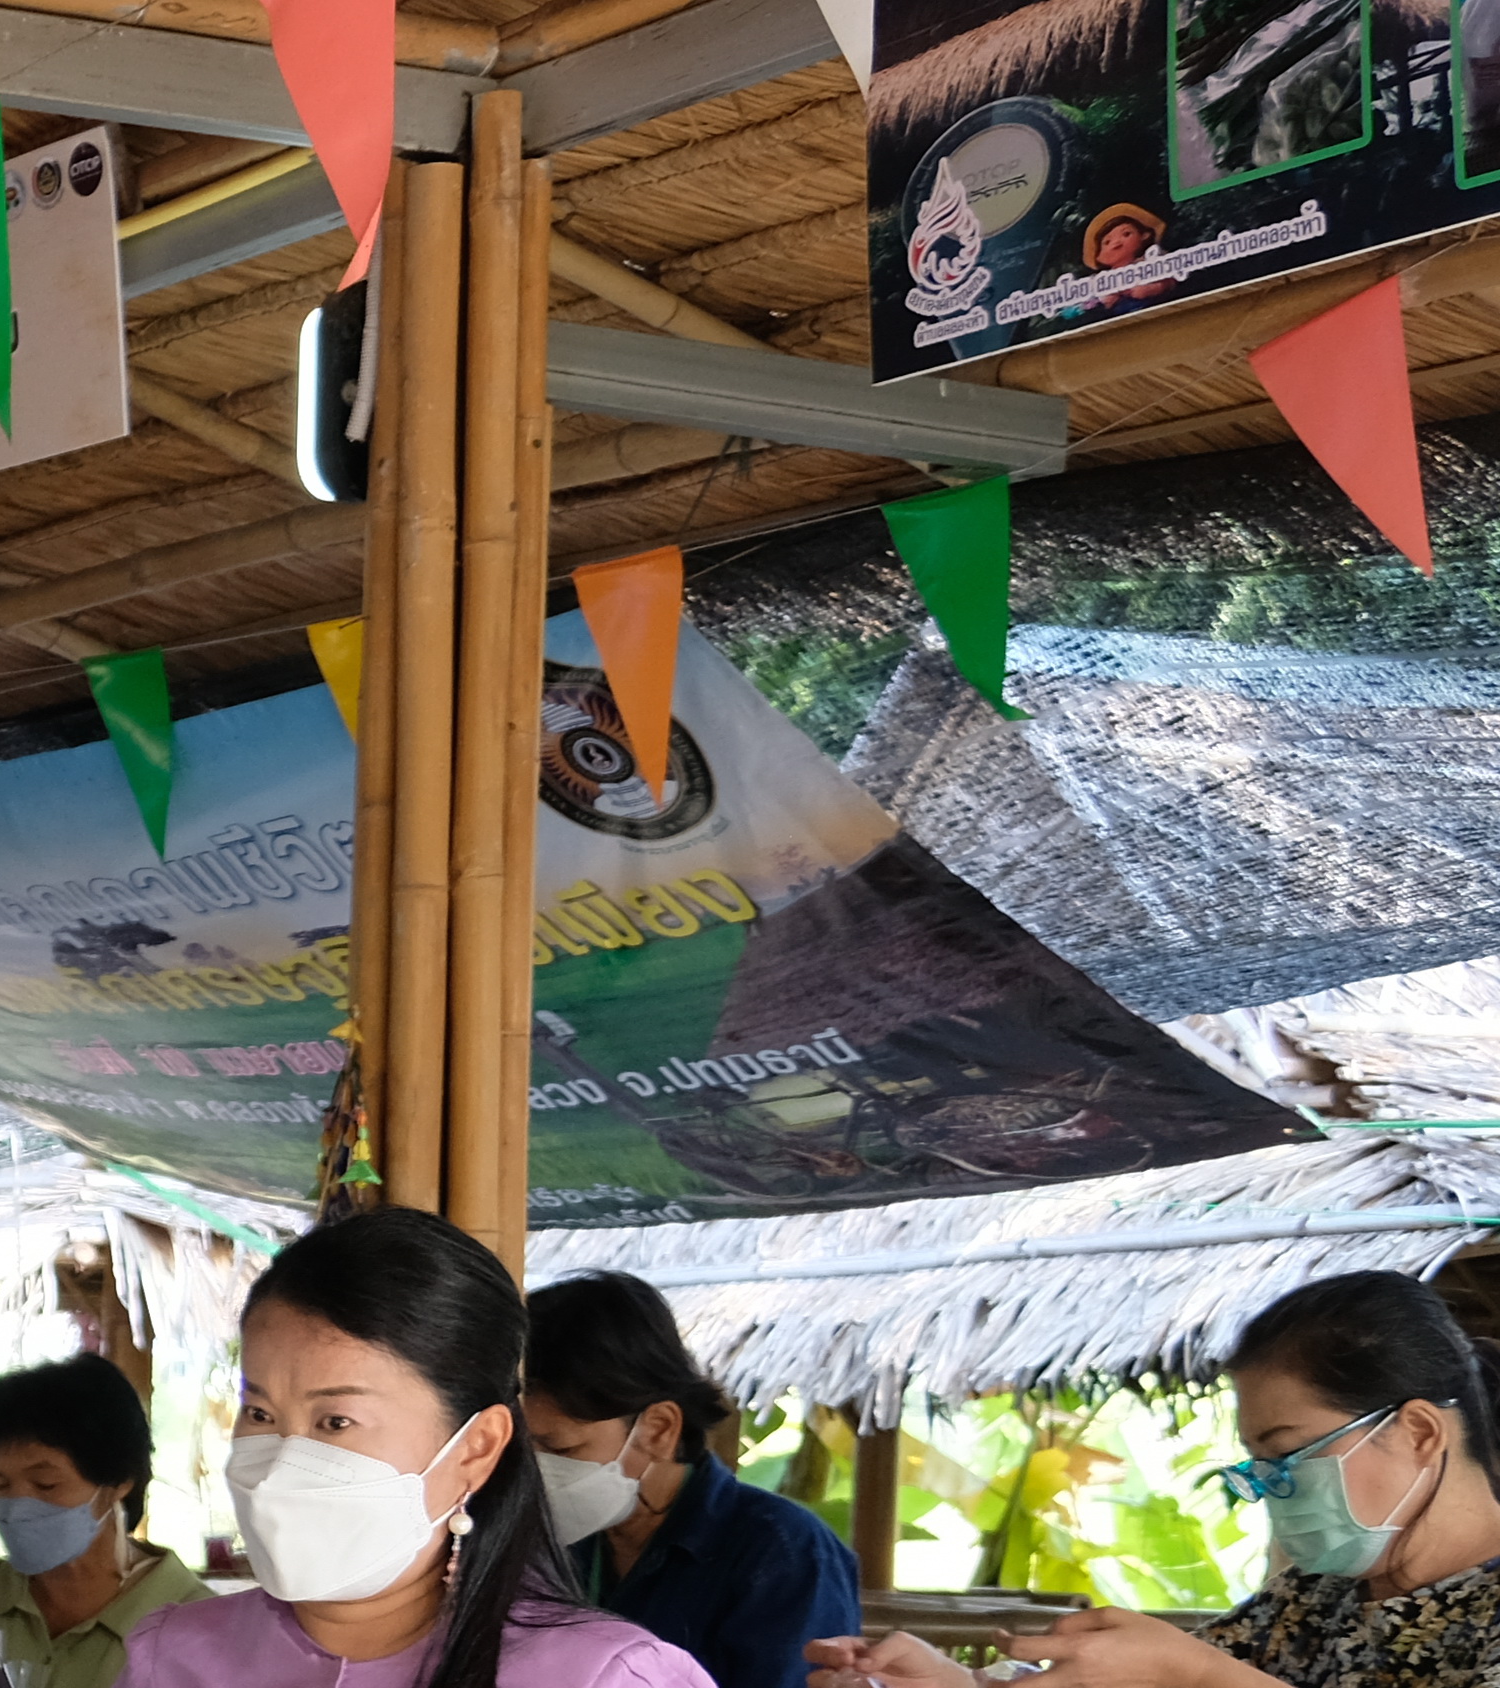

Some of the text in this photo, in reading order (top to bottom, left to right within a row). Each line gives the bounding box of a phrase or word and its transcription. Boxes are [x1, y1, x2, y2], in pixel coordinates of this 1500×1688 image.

[998, 278, 1089, 320] สนับสนุนโดย
[617, 1026, 864, 1099] จ.ปทุมธานี
